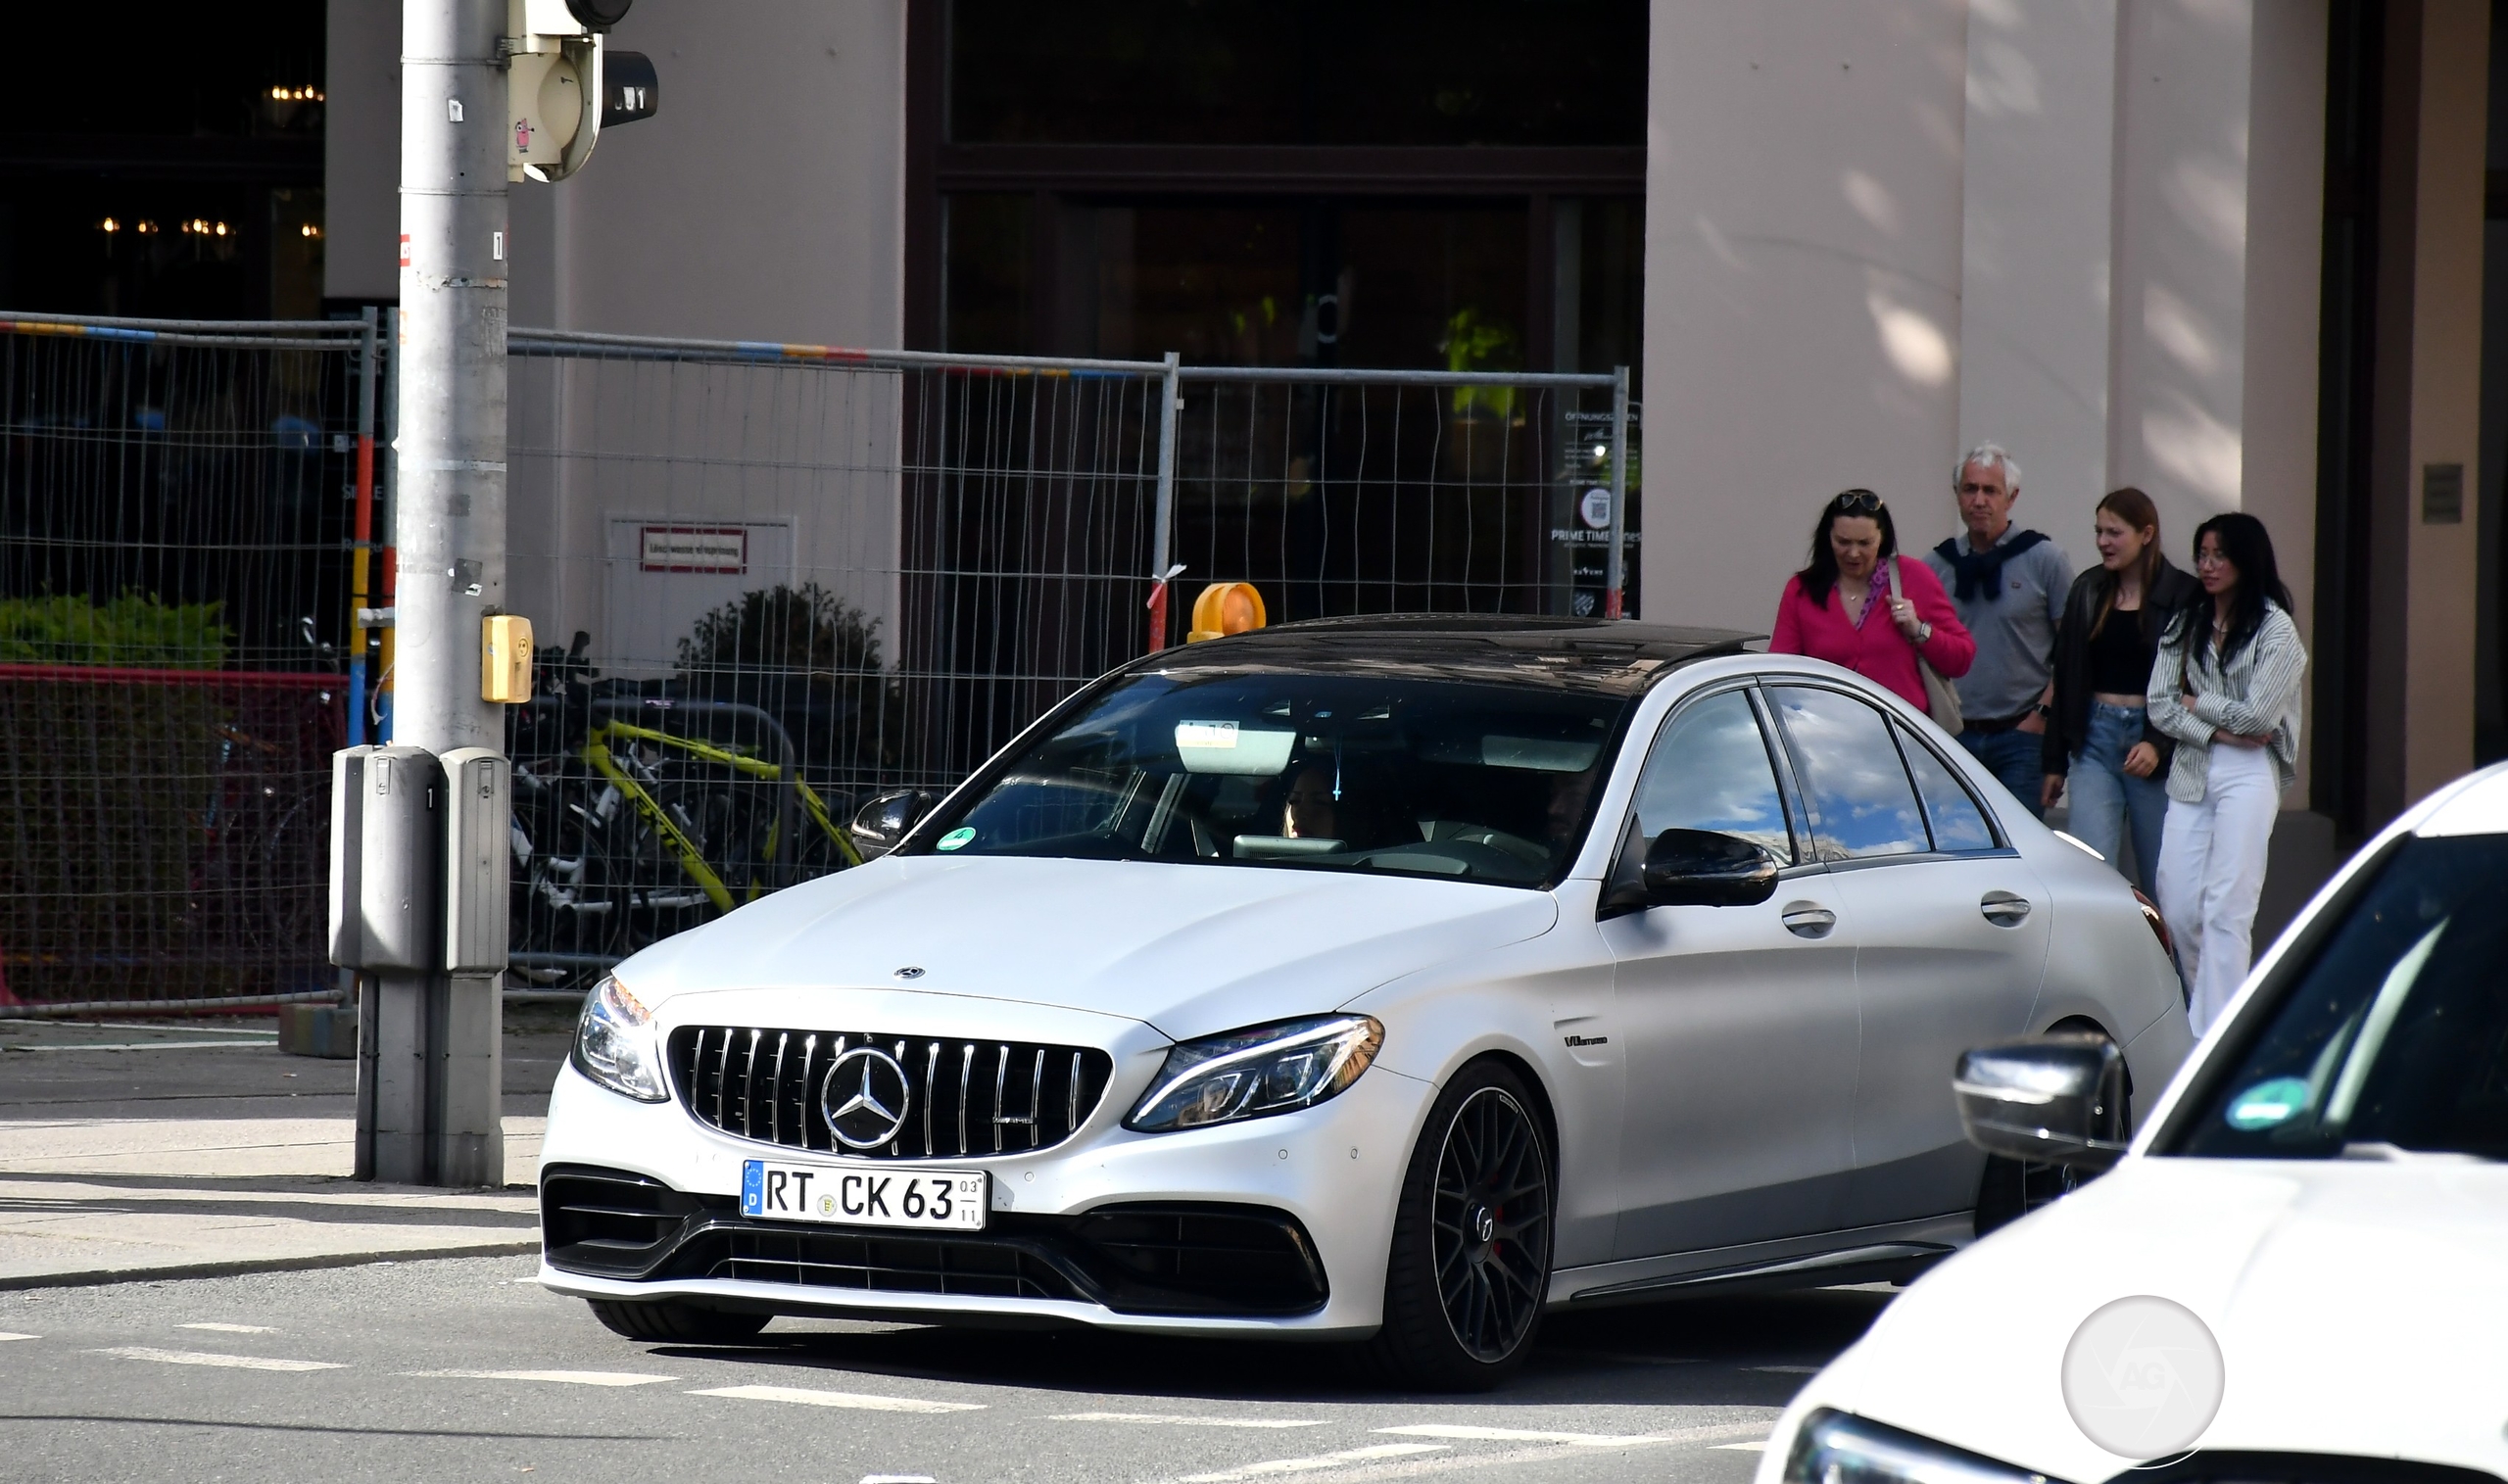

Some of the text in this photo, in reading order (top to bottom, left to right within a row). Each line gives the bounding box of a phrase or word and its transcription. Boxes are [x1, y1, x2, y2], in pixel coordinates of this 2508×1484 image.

[1551, 530, 1584, 542] PRIME
[1585, 530, 1610, 542] TIME
[427, 788, 433, 808] 1
[959, 1180, 978, 1193] 03
[748, 1193, 757, 1207] D
[766, 1170, 953, 1220] RT CK 63
[960, 1209, 976, 1222] 11
